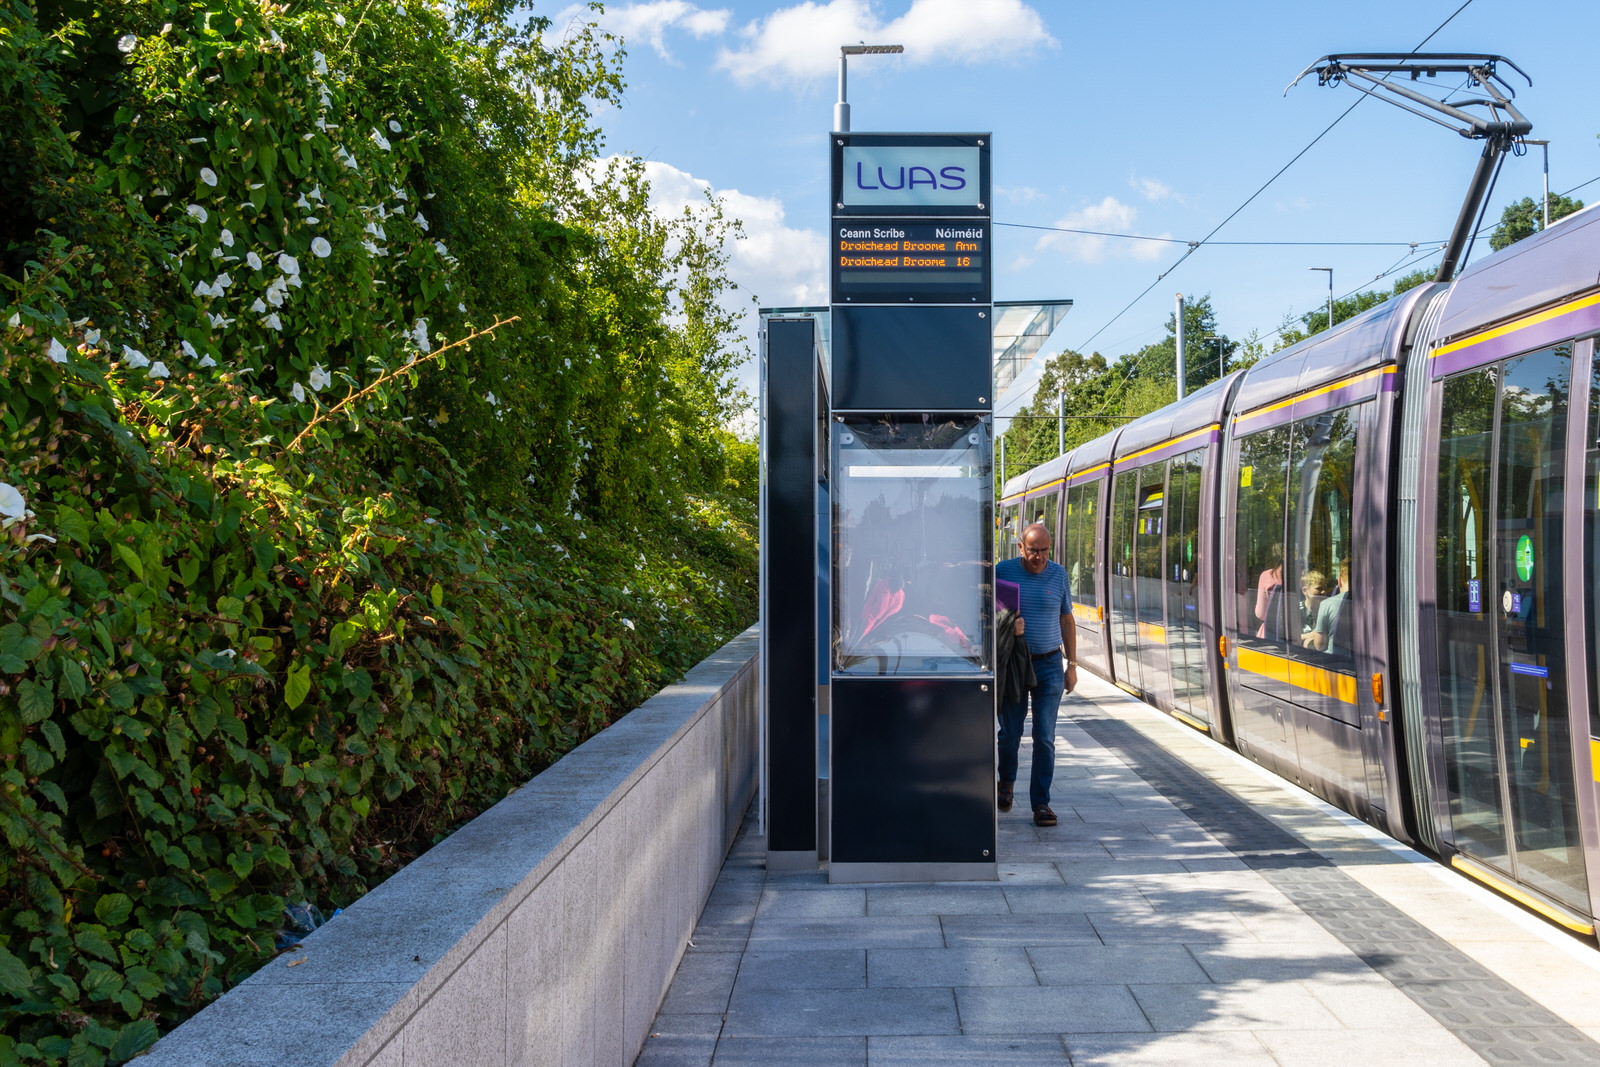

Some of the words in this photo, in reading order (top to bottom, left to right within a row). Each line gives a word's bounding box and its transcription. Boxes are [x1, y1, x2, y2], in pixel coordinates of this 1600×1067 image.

[857, 162, 966, 190] LUAS
[840, 228, 871, 239] Ceann
[936, 228, 983, 239] Nóiméid
[840, 241, 899, 251] Droichead
[903, 241, 946, 251] Broome
[955, 241, 977, 251] Ann
[840, 257, 899, 267] Droichead
[903, 257, 946, 267] Broome
[956, 257, 971, 267] 16
